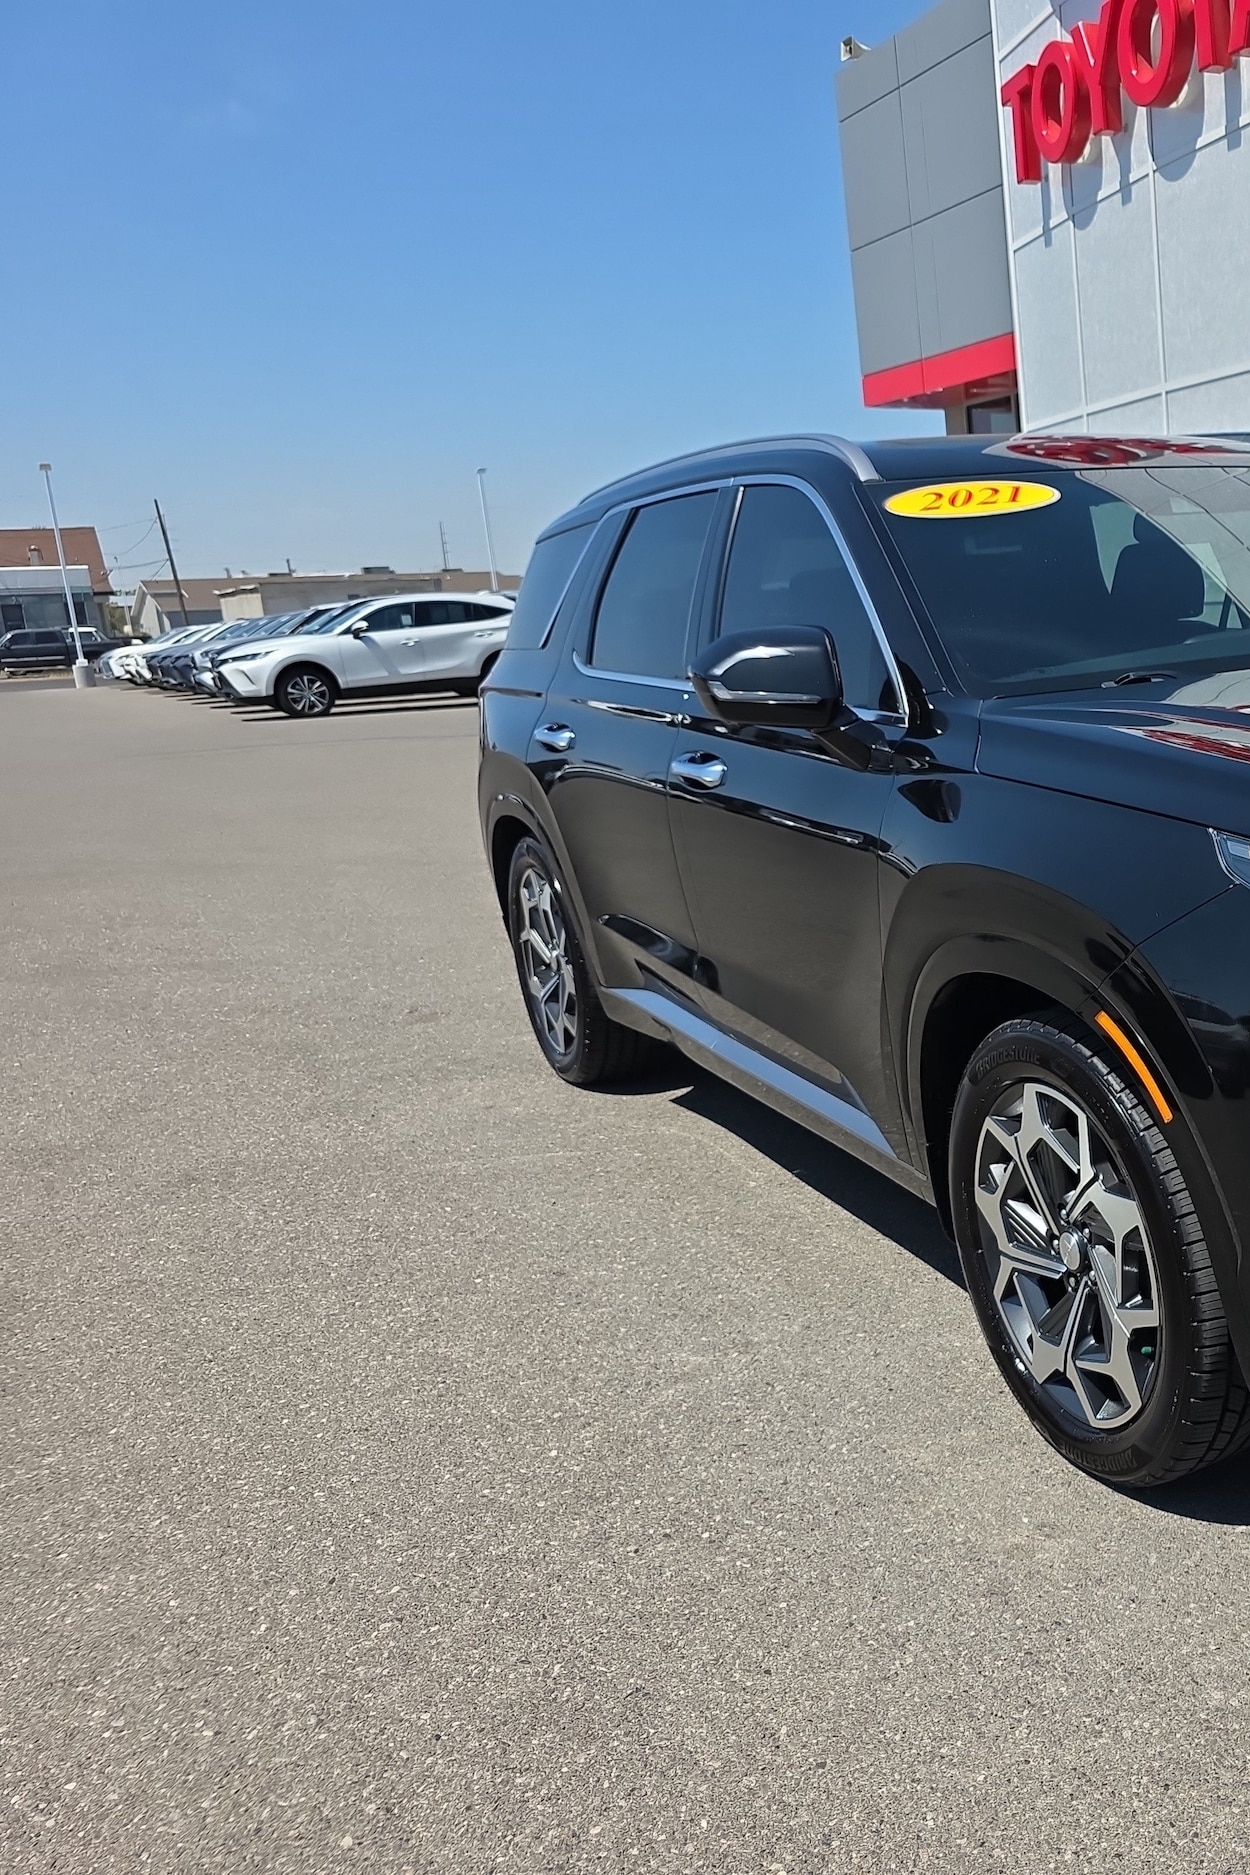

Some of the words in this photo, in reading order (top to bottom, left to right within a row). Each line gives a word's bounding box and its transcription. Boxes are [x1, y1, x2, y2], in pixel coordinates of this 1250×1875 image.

[920, 486, 1022, 511] 2021
[975, 1047, 1041, 1081] BRIDGESTONE
[1059, 1441, 1138, 1472] BRIDGESTONE
